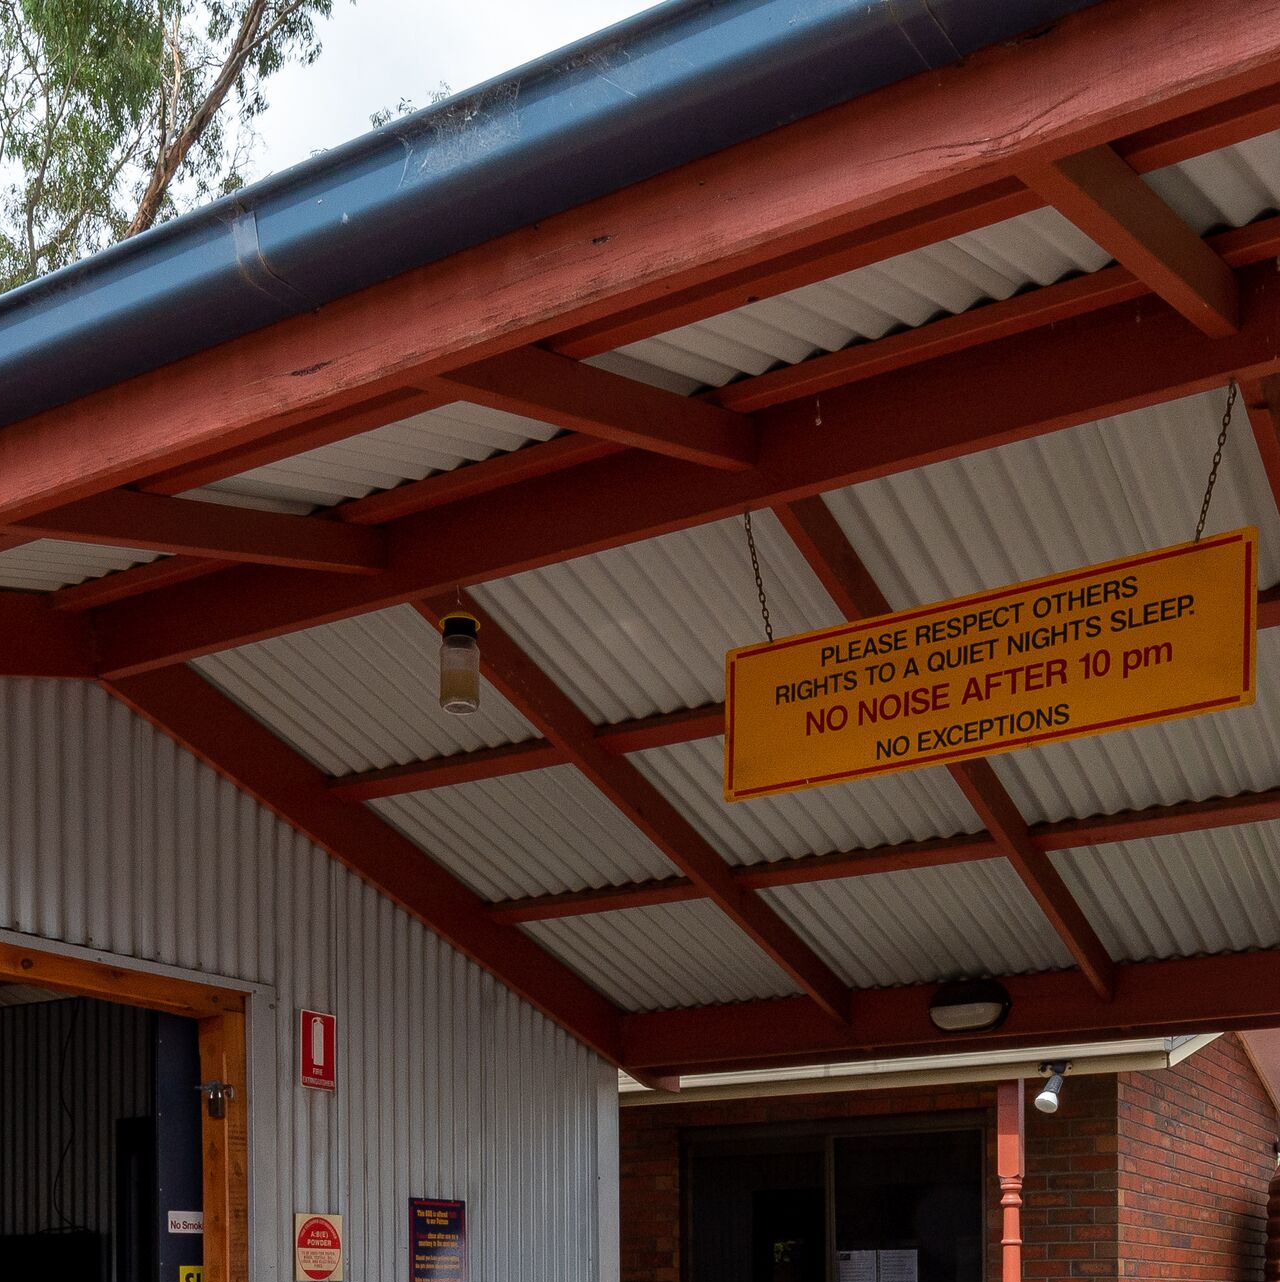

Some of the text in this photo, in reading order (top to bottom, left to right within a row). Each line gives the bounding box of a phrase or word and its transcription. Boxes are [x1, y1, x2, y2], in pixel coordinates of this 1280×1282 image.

[776, 670, 857, 706] RIGHTS
[864, 662, 896, 686] TO
[903, 657, 920, 679] A
[927, 638, 1000, 672] QUIET
[1007, 615, 1102, 655] NIGHTS
[821, 576, 1138, 667] PLEASE RESPECT OTHERS
[806, 642, 1173, 737] NO NOISE AFTER 10 pm
[877, 704, 1070, 760] NO EXCEPTIONS
[170, 1220, 181, 1230] No
